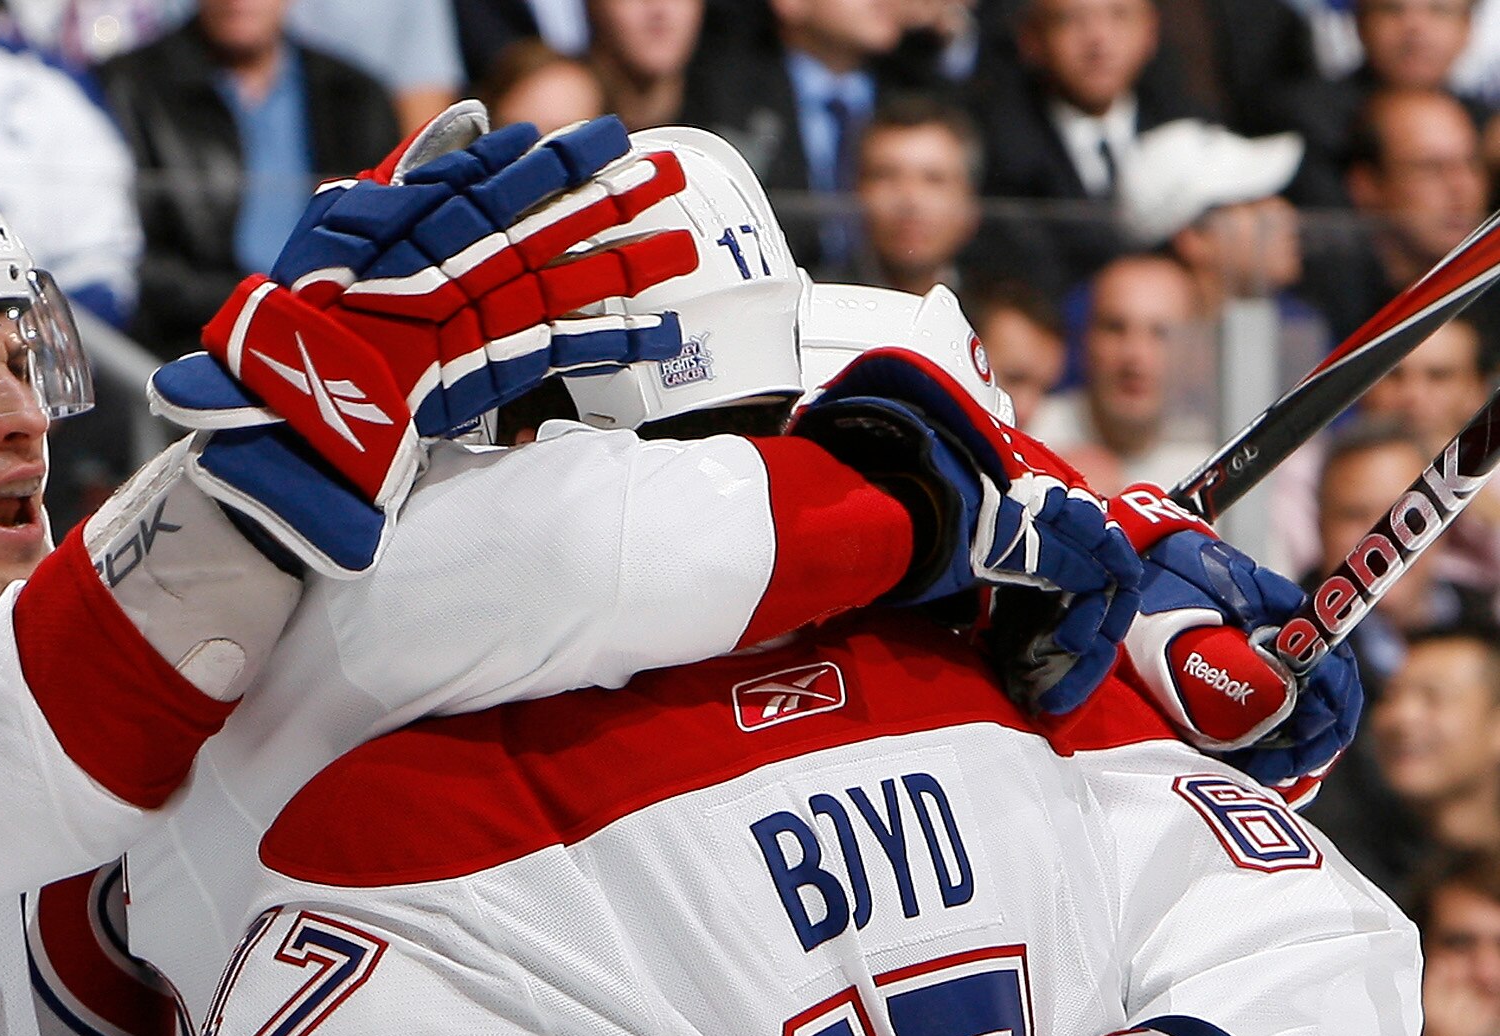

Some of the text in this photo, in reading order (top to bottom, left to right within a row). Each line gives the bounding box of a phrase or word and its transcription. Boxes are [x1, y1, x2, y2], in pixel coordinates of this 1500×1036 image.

[716, 224, 771, 279] 17
[665, 367, 706, 386] CANCER
[1183, 652, 1255, 705] Reebok
[1171, 773, 1324, 873] 6
